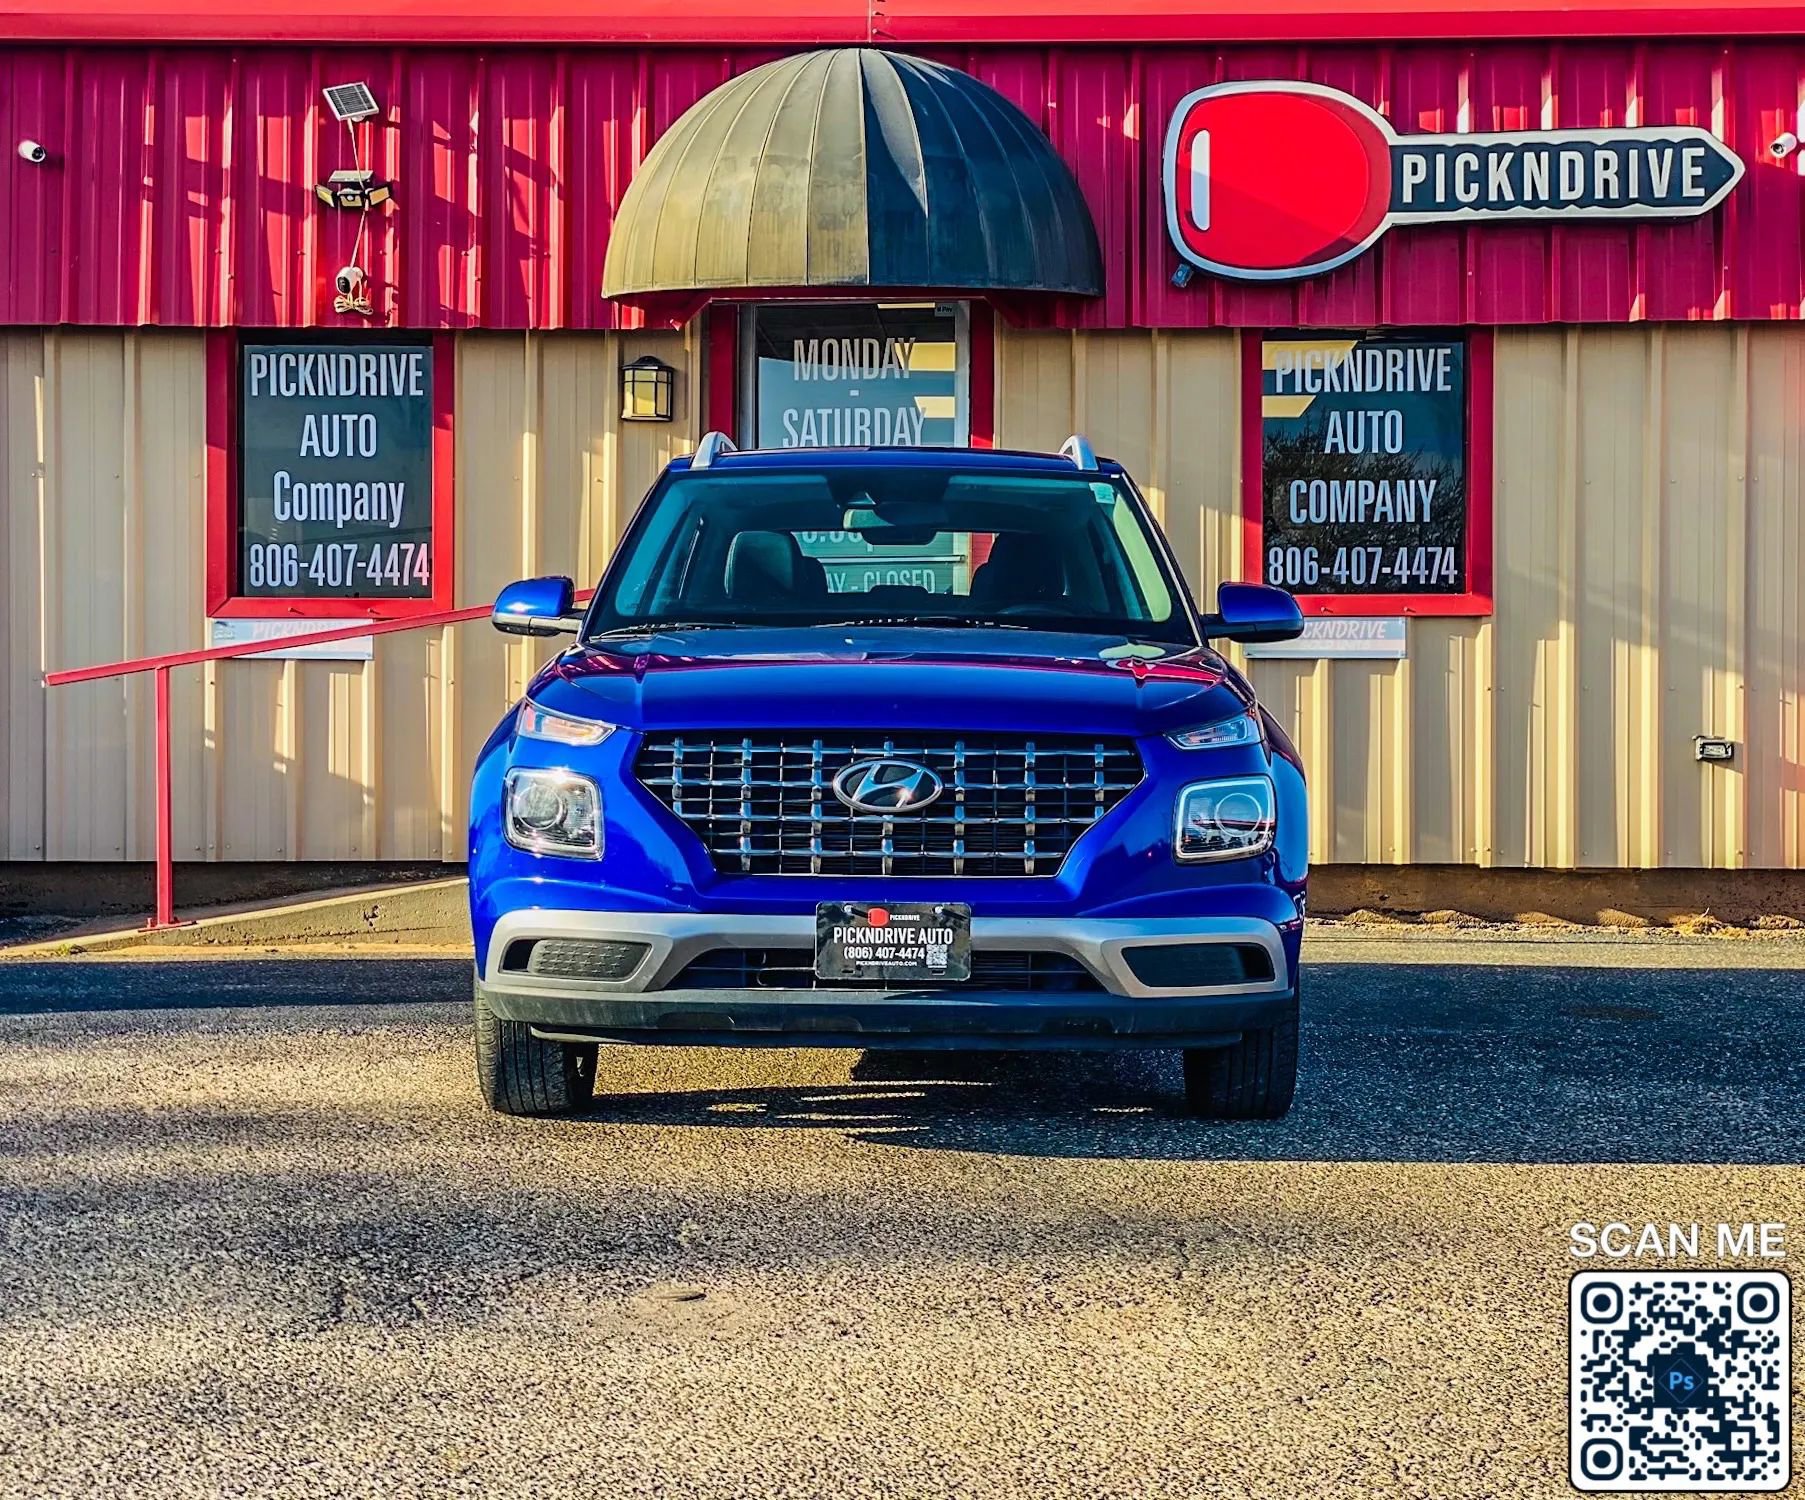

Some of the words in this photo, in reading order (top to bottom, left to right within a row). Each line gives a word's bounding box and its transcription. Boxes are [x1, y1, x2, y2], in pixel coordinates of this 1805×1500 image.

[1402, 147, 1706, 204] PICKNDRIVE
[251, 353, 424, 397] PICKNDRIVE
[794, 337, 916, 381] MONDAY
[1275, 348, 1452, 394] PICKNDRIVE
[299, 413, 377, 458] AUTO
[782, 406, 927, 447] SATURDAY
[1324, 409, 1403, 455] AUTO
[273, 470, 405, 529] Company
[1289, 479, 1437, 524] COMPANY
[249, 543, 430, 587] 806-407-4474
[863, 569, 936, 594] CLOSED
[1268, 546, 1458, 586] 806-407-4474
[1303, 621, 1387, 639] CKNDRIVE
[833, 927, 916, 945] PICKNDRIVE
[918, 928, 953, 945] AUTO
[844, 946, 873, 960] (806)
[875, 947, 925, 960] 407-4474
